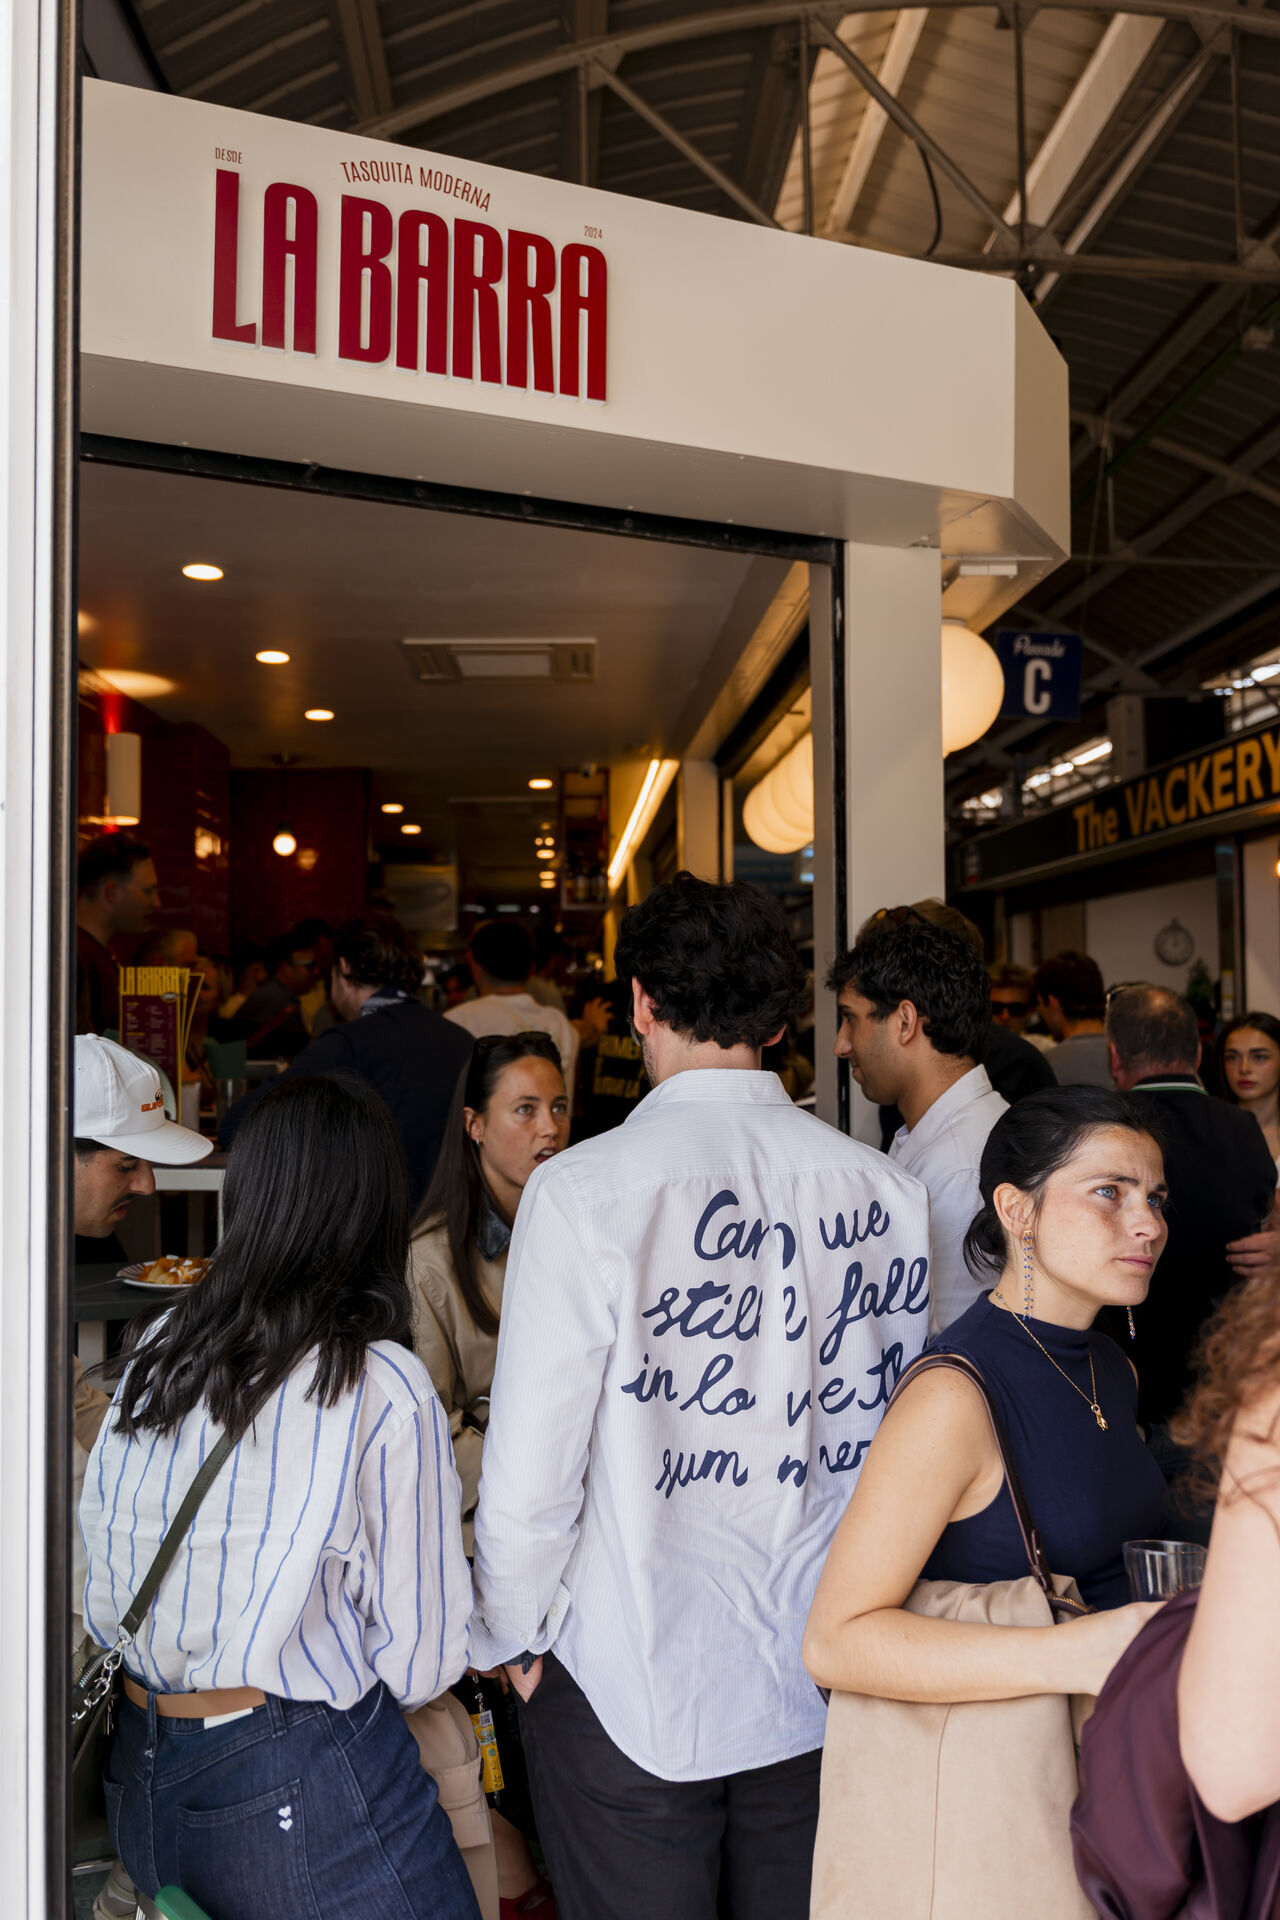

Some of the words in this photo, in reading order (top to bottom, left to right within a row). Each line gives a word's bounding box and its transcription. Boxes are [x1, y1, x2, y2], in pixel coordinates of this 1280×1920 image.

[215, 147, 243, 165] DESDE
[340, 161, 413, 186] TASQUITA
[419, 168, 491, 213] MODERNA
[584, 225, 603, 239] 2024
[212, 168, 318, 358] LA
[338, 194, 608, 405] BARRA
[1023, 658, 1053, 715] C
[1073, 801, 1119, 852] The
[819, 1200, 890, 1250] we
[819, 1257, 929, 1366] fall
[620, 1353, 678, 1403] in
